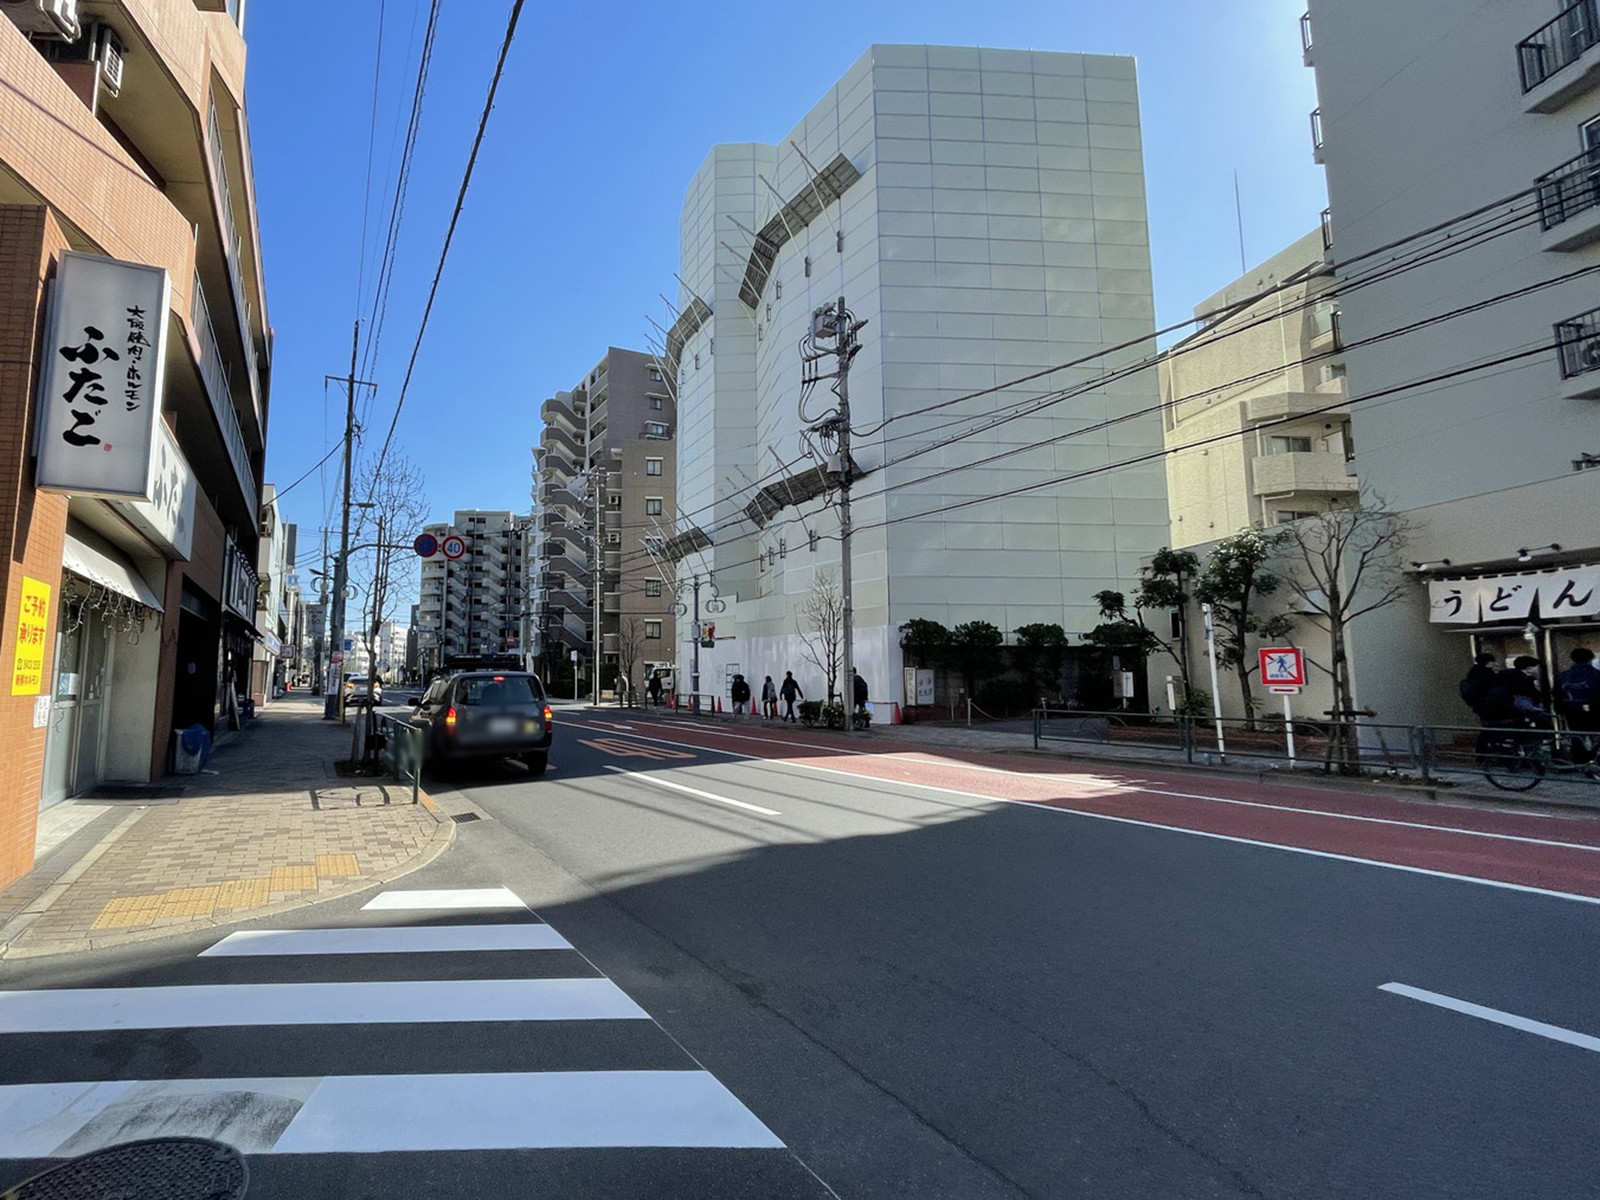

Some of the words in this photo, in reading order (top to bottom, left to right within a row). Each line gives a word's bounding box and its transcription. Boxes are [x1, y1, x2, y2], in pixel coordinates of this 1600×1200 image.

[59, 326, 119, 446] ふたご
[447, 542, 460, 554] 40
[1443, 579, 1594, 618] うどん
